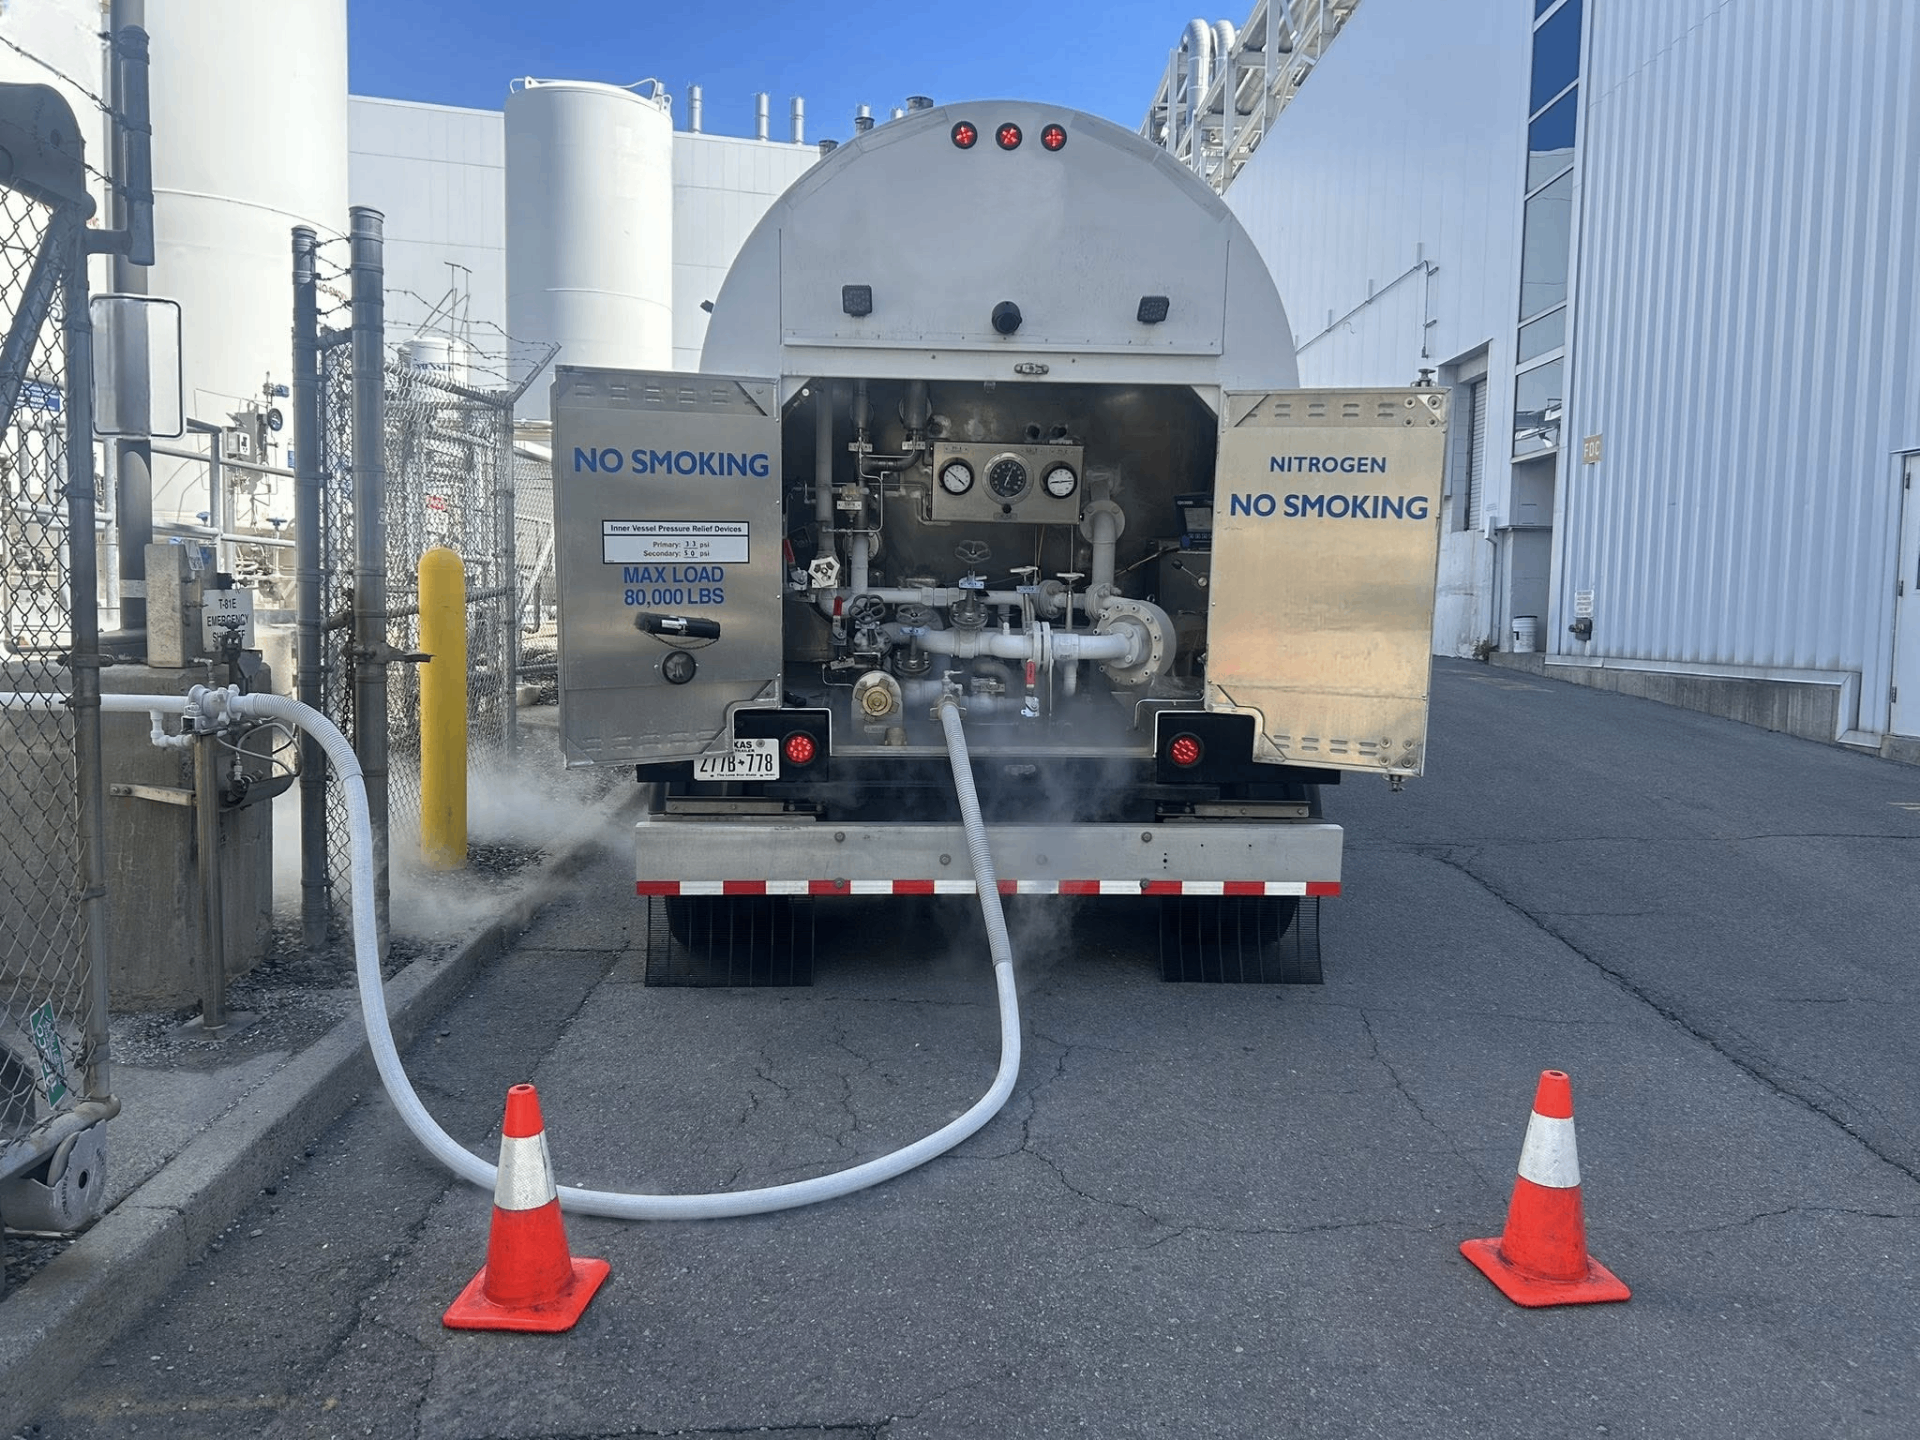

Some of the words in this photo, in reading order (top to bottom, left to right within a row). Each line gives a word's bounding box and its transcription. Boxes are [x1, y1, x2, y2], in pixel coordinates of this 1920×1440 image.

[1584, 441, 1601, 458] FDC
[574, 447, 623, 473] NO
[632, 449, 769, 477] SMOKING
[1270, 456, 1386, 473] NITROGEN
[1230, 493, 1276, 517] NO
[1283, 493, 1428, 520] SMOKING
[714, 525, 742, 533] Devices
[652, 541, 681, 550] Primary:
[699, 542, 710, 550] psi
[643, 550, 681, 559] Secondary:
[624, 566, 667, 583] MAX
[673, 567, 724, 583] LOAD
[218, 598, 237, 609] T-81E
[624, 588, 684, 608] 80,000
[687, 588, 725, 604] LBS
